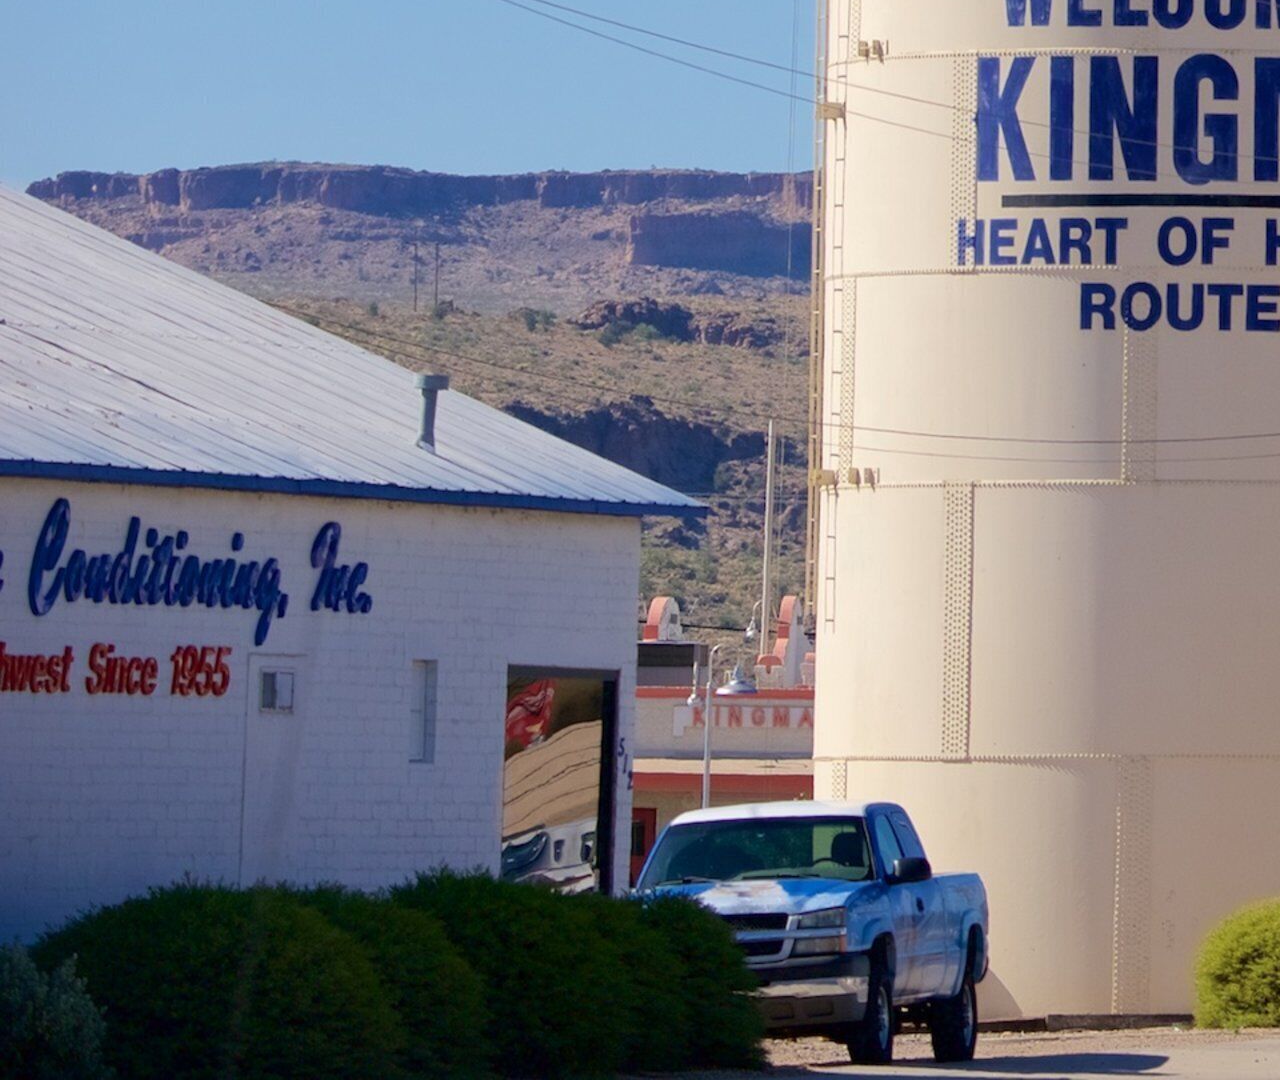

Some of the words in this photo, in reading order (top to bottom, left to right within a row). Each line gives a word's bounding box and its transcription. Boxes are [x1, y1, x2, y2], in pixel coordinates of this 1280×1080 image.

[956, 217, 1129, 266] HEART
[1157, 216, 1235, 267] OF
[310, 521, 373, 614] Inc.
[85, 642, 158, 695] Since
[170, 645, 232, 696] 1955
